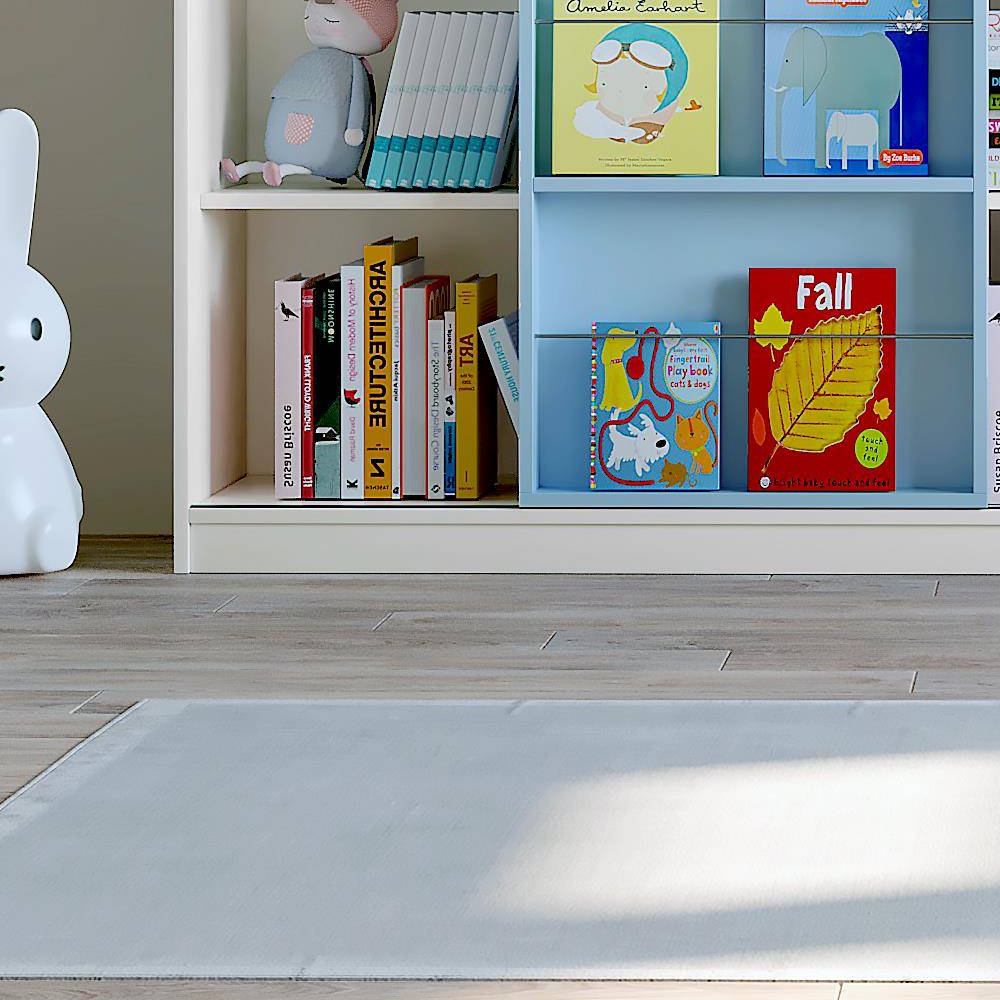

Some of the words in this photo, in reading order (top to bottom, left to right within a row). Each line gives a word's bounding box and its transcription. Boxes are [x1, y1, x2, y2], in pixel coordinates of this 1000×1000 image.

[566, 0, 630, 13] Amelia
[636, 0, 705, 13] Earhart
[797, 273, 852, 311] Fall
[667, 365, 687, 379] Play
[689, 365, 713, 376] book
[670, 380, 686, 388] cats
[861, 434, 883, 445] touch
